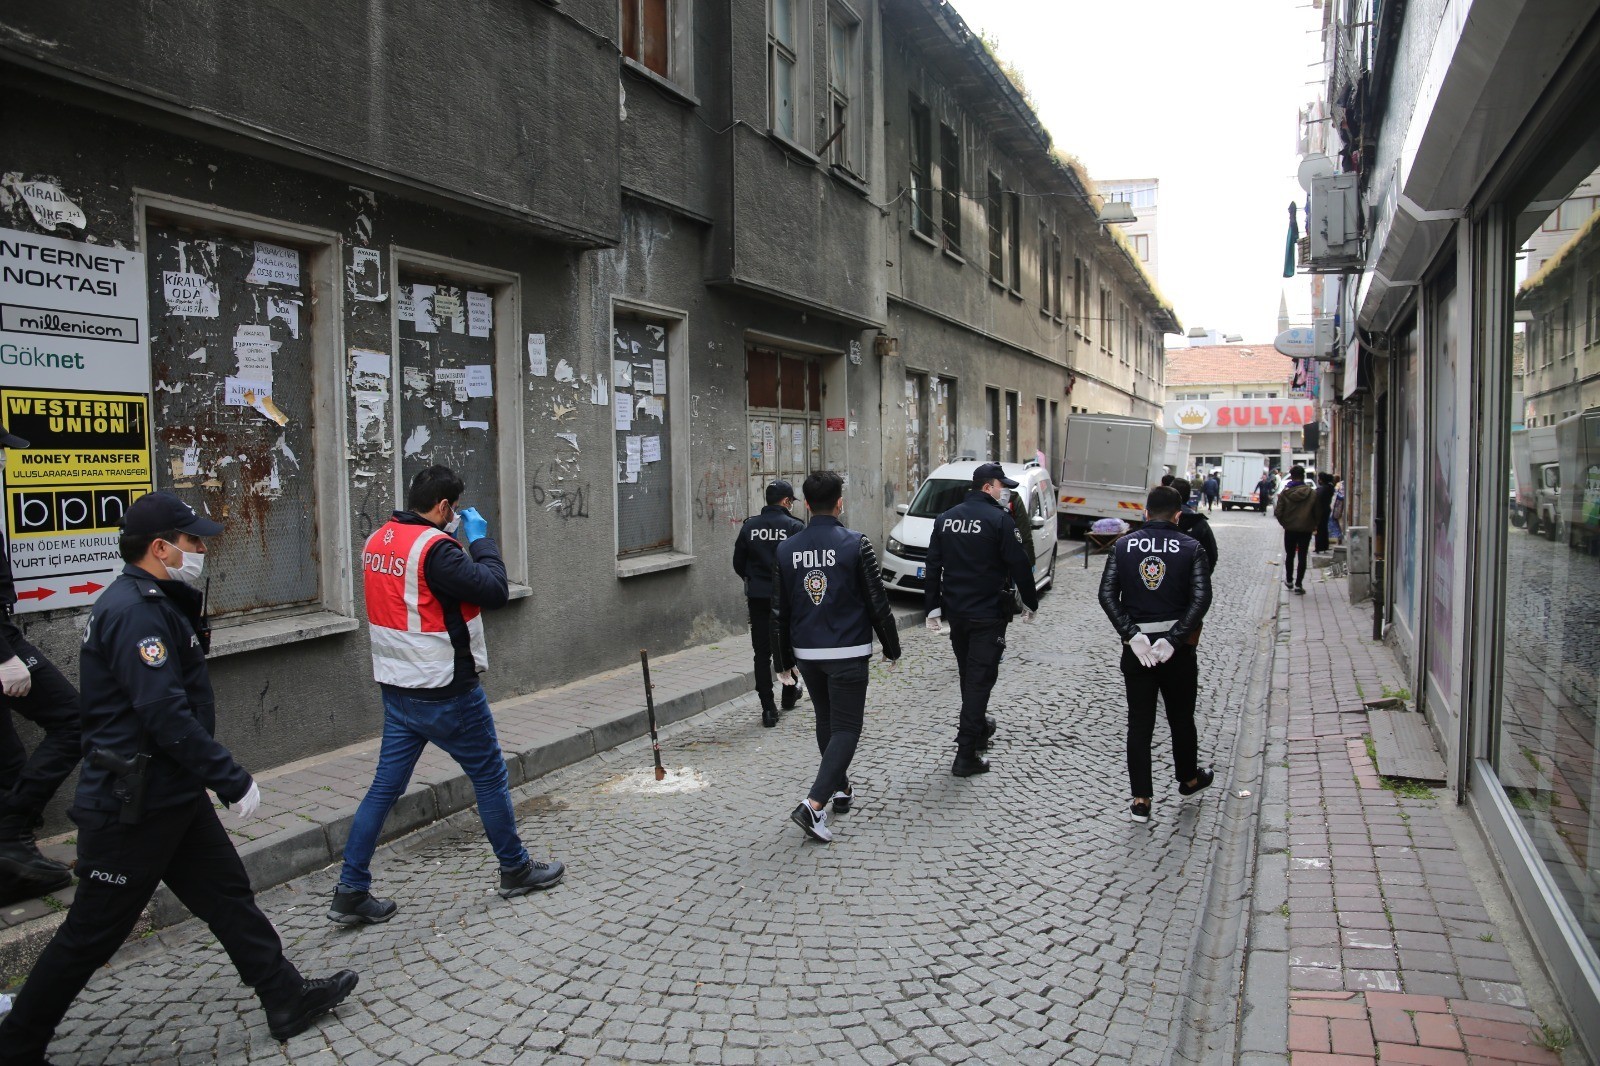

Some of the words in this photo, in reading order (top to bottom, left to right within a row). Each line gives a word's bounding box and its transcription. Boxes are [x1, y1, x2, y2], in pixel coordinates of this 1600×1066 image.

[23, 185, 69, 203] KİRALI
[0, 239, 125, 274] NTERNET
[3, 266, 117, 297] NOKTASI
[172, 288, 201, 300] ODA
[20, 314, 123, 337] millenicom
[0, 344, 85, 369] Göknet
[9, 398, 124, 417] WESTERN
[49, 416, 125, 433] UNION
[21, 454, 71, 464] MONEY
[75, 454, 140, 463] TRANSFER
[13, 469, 80, 478] ULUSLARARASI
[81, 468, 104, 476] PARA
[105, 467, 147, 476] TRANSFERİ
[20, 492, 124, 531] bpn
[11, 542, 34, 553] BPN
[37, 539, 76, 551] ÖDEME
[79, 536, 120, 548] KURULU
[13, 557, 46, 568] YURT
[49, 554, 61, 568] İÇİ
[64, 550, 122, 564] PARATRAN
